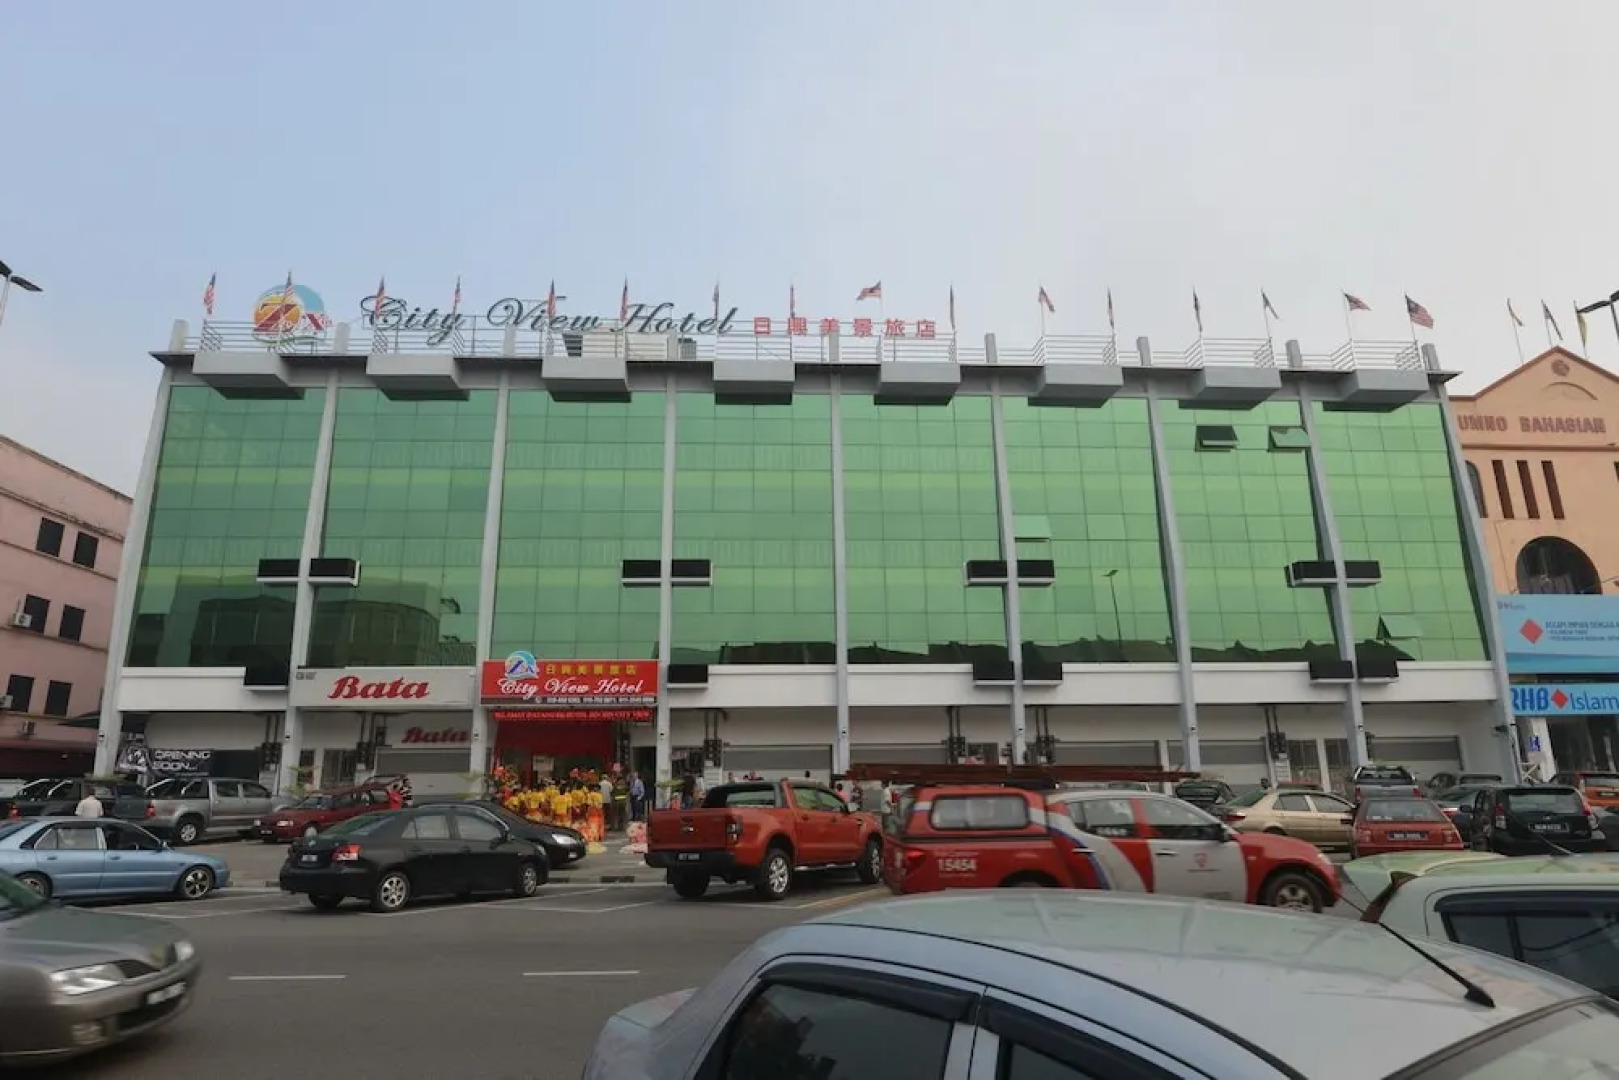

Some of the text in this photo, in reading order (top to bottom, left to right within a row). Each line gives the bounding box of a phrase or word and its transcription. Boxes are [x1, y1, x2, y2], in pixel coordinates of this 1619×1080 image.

[361, 296, 463, 345] City
[487, 296, 602, 330] View
[610, 303, 738, 334] Hotel
[1457, 415, 1508, 431] UMNO
[327, 675, 431, 699] Bata
[497, 676, 644, 699] City View Hotel
[1510, 687, 1549, 711] RHB
[402, 726, 469, 744] Bata
[155, 750, 211, 759] OPENING
